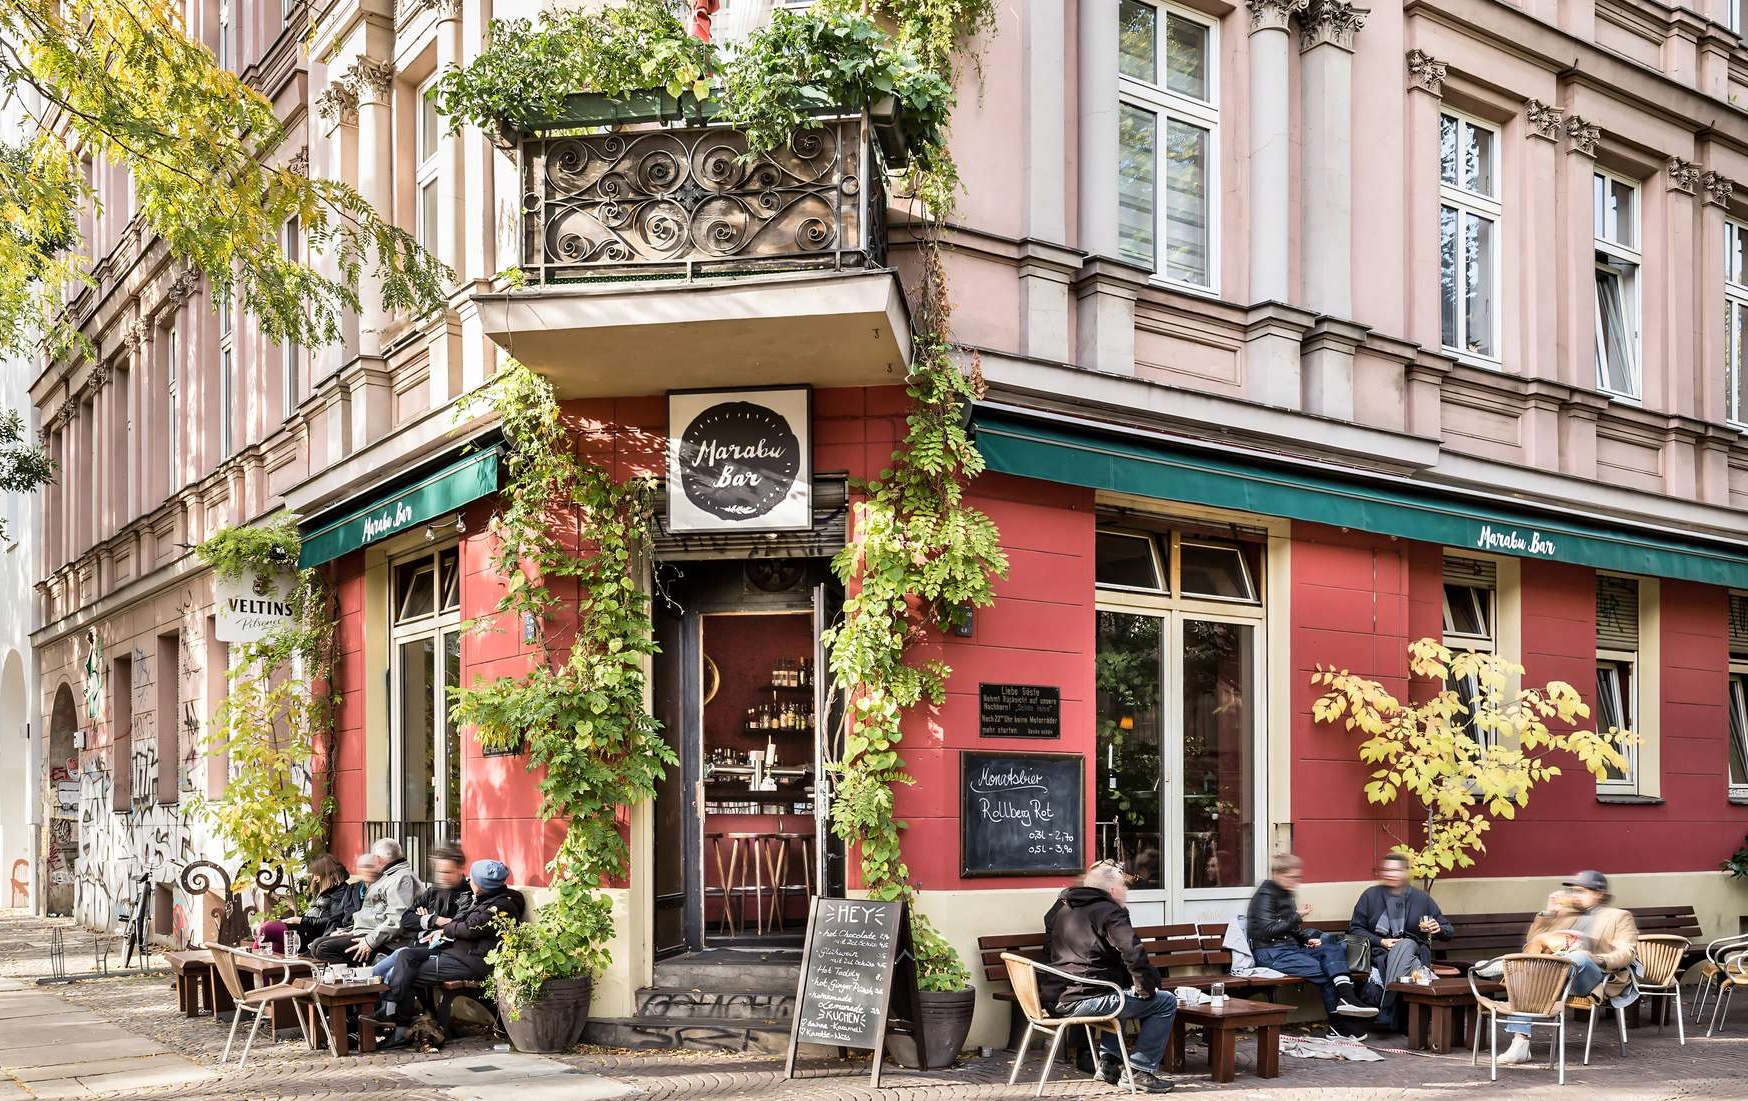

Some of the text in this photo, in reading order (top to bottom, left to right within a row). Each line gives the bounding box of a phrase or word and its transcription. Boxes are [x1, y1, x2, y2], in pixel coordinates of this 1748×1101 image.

[692, 438, 786, 467] Marabu
[713, 465, 762, 488] Bar
[362, 501, 413, 543] Marabu Bar
[1477, 525, 1555, 555] Marabu Bar
[227, 597, 294, 617] VELTINS
[978, 767, 1043, 787] Monatsbier
[979, 797, 1055, 827] Rollberg Rot
[1055, 830, 1074, 842] 2,70
[837, 905, 876, 924] HEY
[839, 929, 877, 940] Chocolate
[817, 965, 832, 974] Hot
[835, 967, 860, 981] Toddy
[814, 977, 828, 988] hot
[828, 978, 853, 993] Ginger
[818, 1001, 865, 1014] Lemonade
[826, 1011, 860, 1024] KUCHEN
